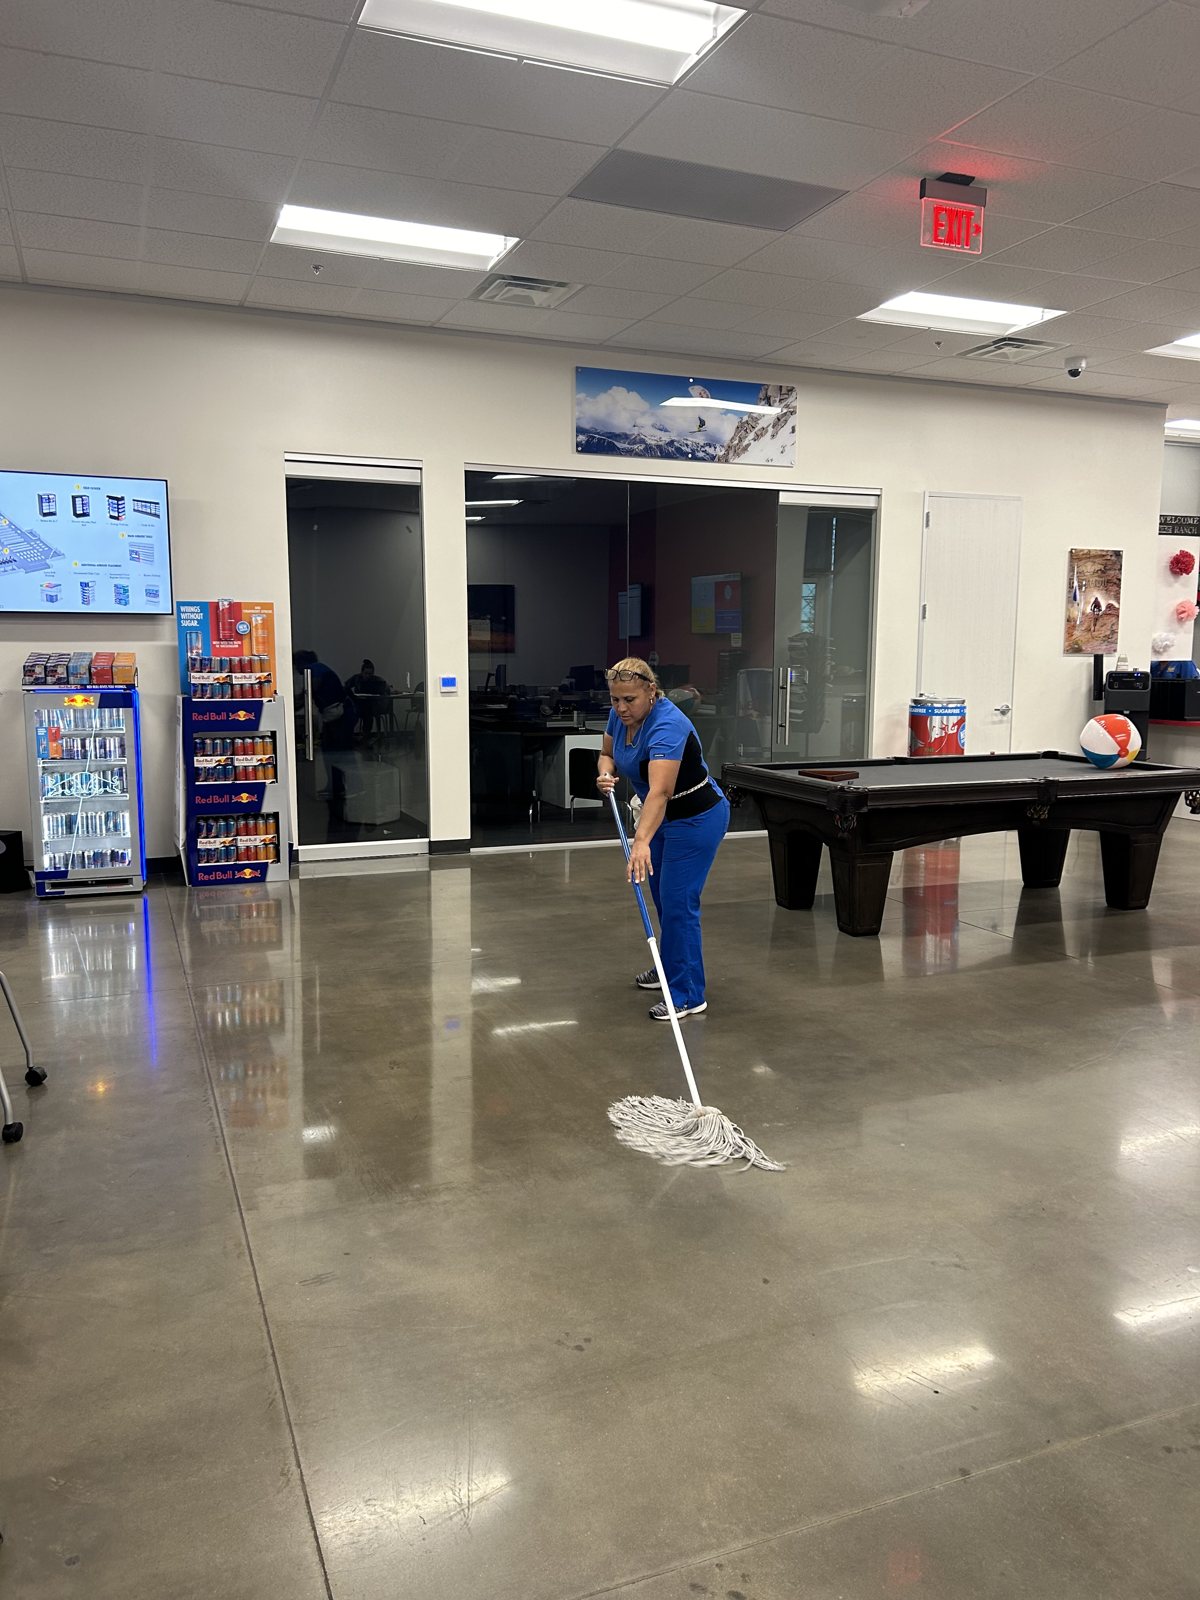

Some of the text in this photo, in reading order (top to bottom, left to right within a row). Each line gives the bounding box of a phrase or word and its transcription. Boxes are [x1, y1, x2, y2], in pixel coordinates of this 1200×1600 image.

[933, 205, 975, 248] EXIT
[180, 612, 203, 620] WITHOUT
[192, 712, 226, 721] Red Bull
[195, 795, 229, 804] Red Bull
[198, 871, 232, 881] Red Bull
